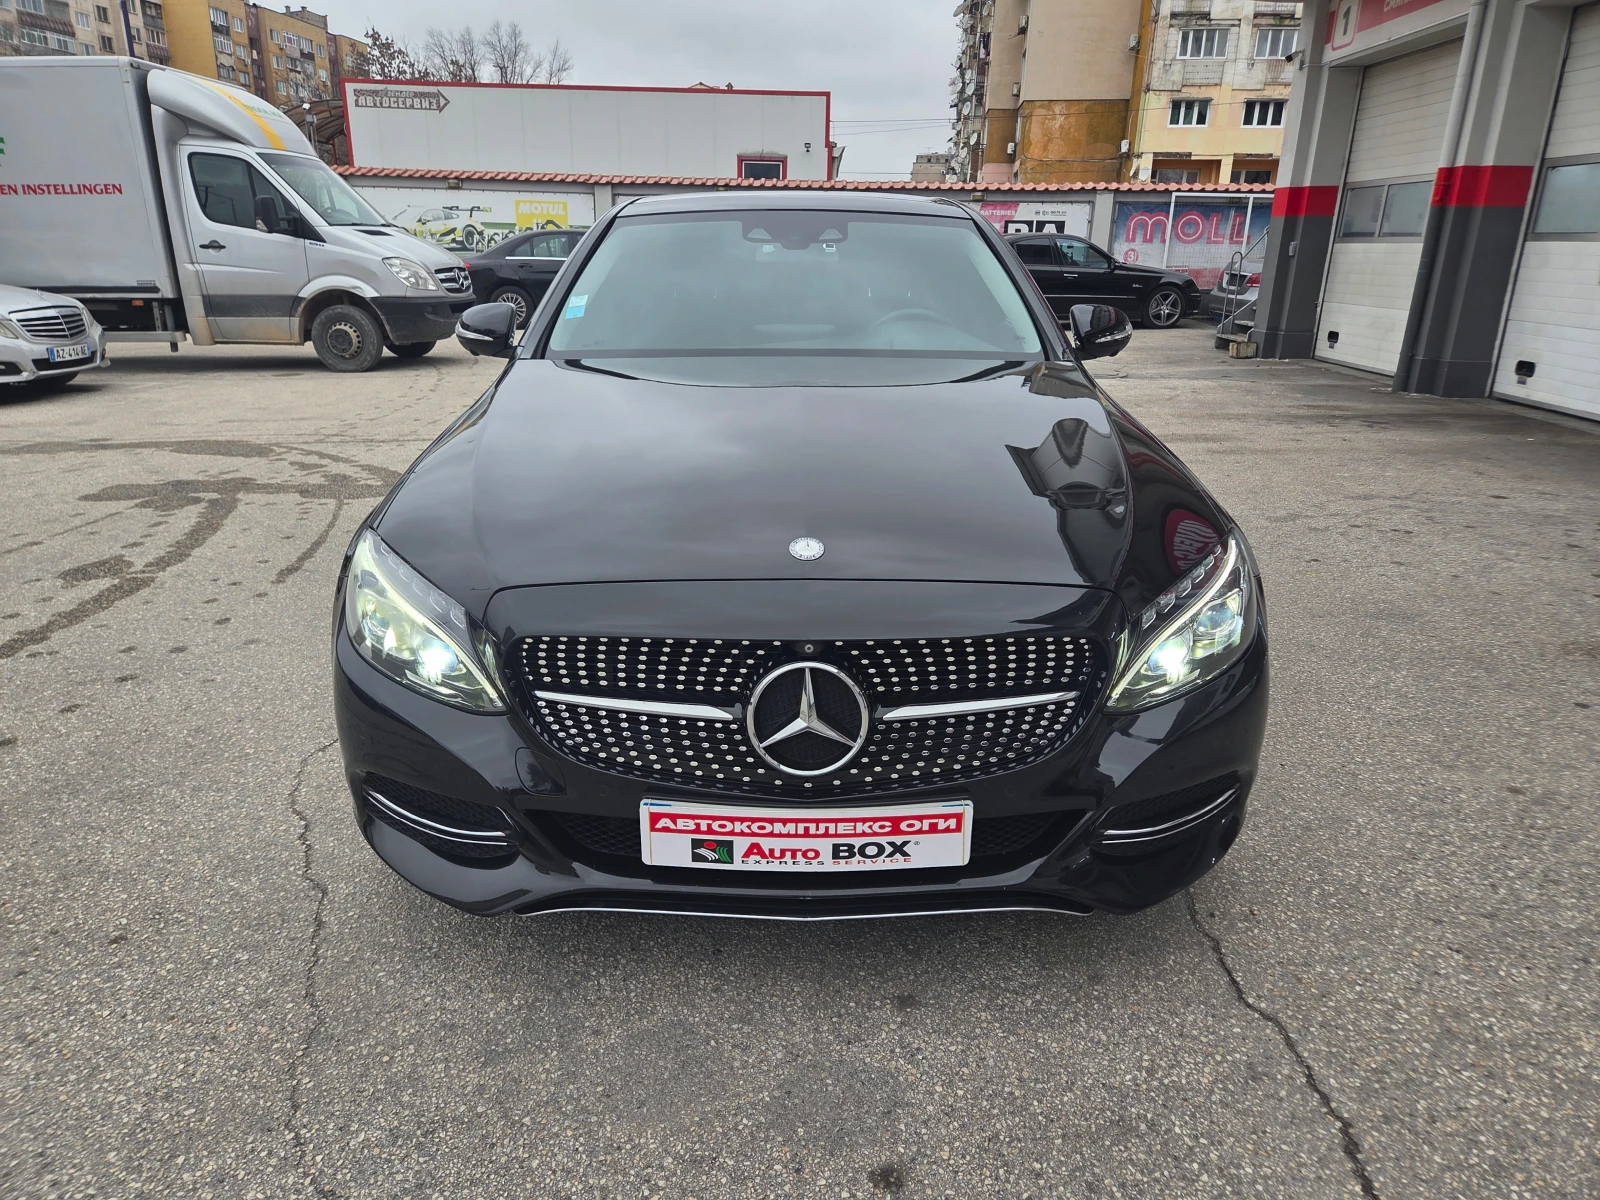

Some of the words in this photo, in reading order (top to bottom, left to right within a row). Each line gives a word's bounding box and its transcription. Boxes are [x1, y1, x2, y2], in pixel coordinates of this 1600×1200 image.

[1342, 5, 1352, 36] 1
[358, 96, 437, 109] АВТОСЕРВИЗ
[21, 183, 123, 195] INSTELLINGEN
[518, 203, 565, 215] MOTUL
[655, 817, 892, 835] АВТОКОМПЛЕКС
[899, 818, 957, 833] ОГИ
